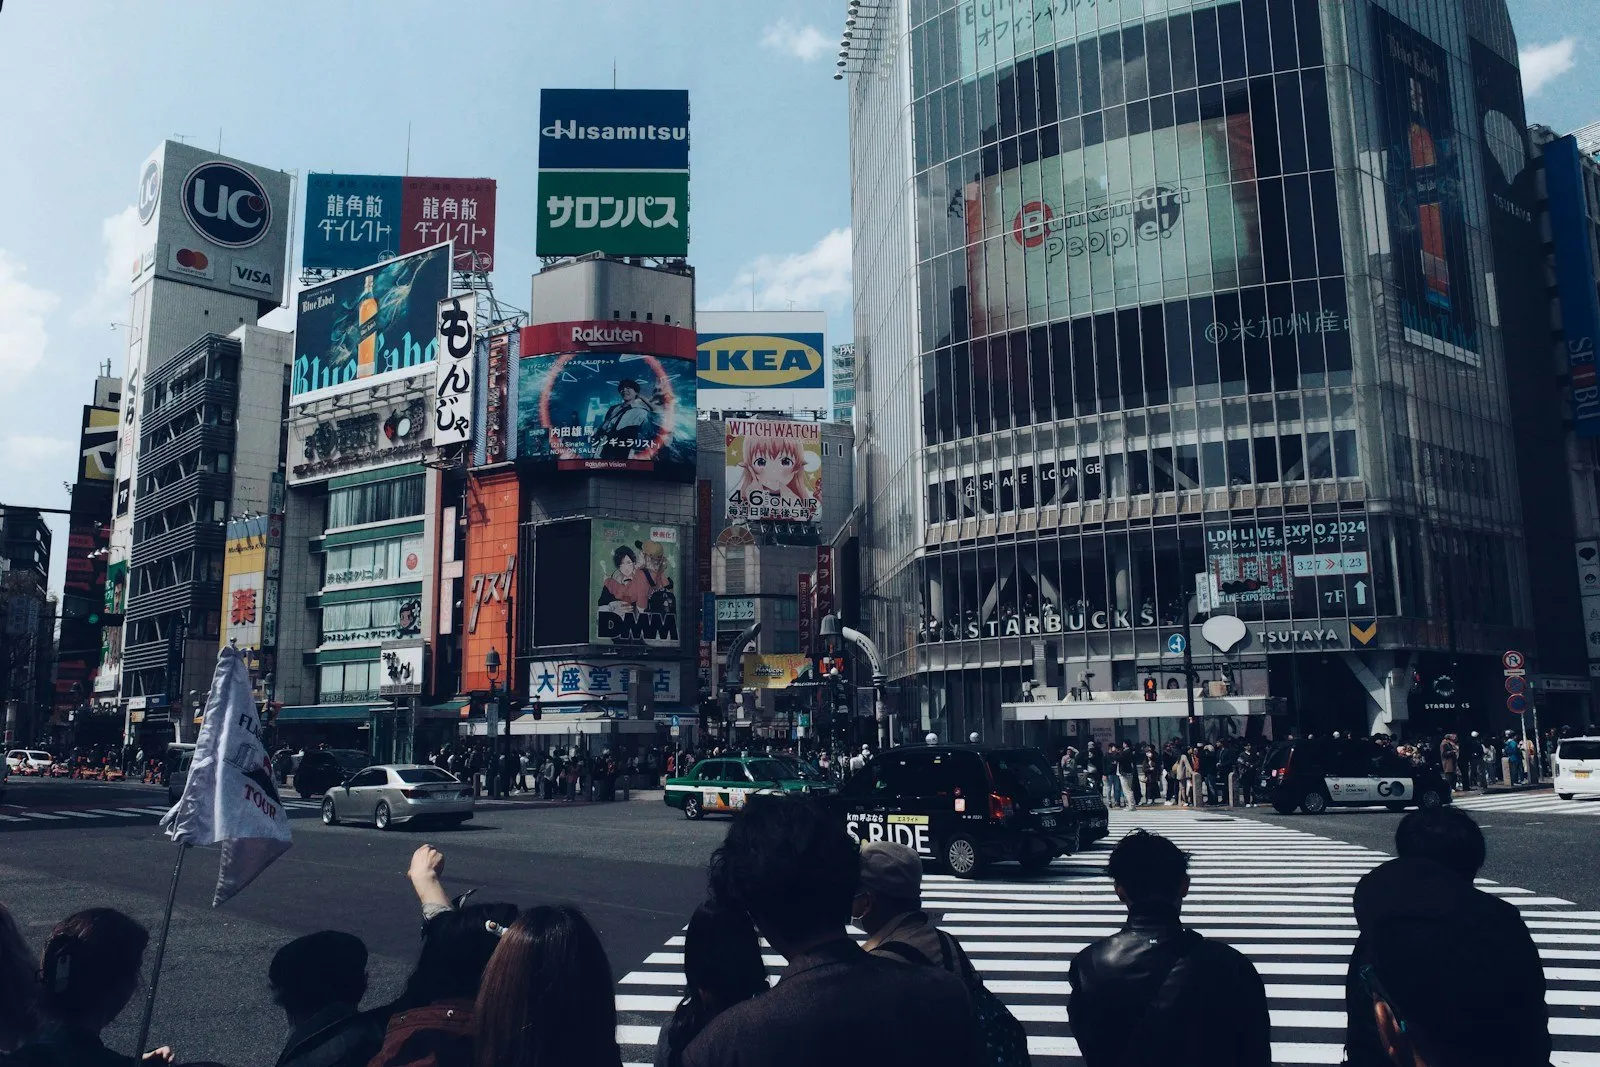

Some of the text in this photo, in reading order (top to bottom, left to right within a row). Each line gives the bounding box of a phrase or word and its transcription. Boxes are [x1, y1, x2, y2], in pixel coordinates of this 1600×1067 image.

[542, 119, 686, 141] Hisamitsu
[194, 177, 263, 229] UC
[327, 193, 383, 218] 龍角散
[422, 196, 478, 221] 龍角散
[547, 195, 679, 229] サロンパス
[317, 219, 392, 243] ダイレクト
[413, 221, 487, 245] ダイレクト
[235, 265, 272, 286] VISA
[572, 325, 643, 344] Rakuten
[437, 299, 472, 438] もんじゃ
[697, 350, 812, 371] IKEA
[1568, 336, 1600, 420] SEIBU
[550, 426, 595, 438] 内田雄馬
[729, 421, 818, 438] WITCH WATCH
[565, 441, 585, 450] Single
[609, 462, 627, 470] Vision
[983, 464, 1101, 491] SHARE LOUNGE
[729, 489, 764, 506] 4.6
[770, 497, 792, 507] ON
[794, 498, 818, 508] AIR
[1207, 520, 1366, 543] LDH LIVE EXPO 2024
[468, 554, 516, 634] クスリ
[1324, 590, 1344, 604] 7F
[231, 587, 256, 626] 薬
[968, 608, 1154, 638] STARBUCKS
[1257, 628, 1338, 643] TSUTAYA
[1378, 780, 1405, 798] GO
[245, 783, 277, 820] TOUR
[846, 812, 884, 823] km呼ぶなら
